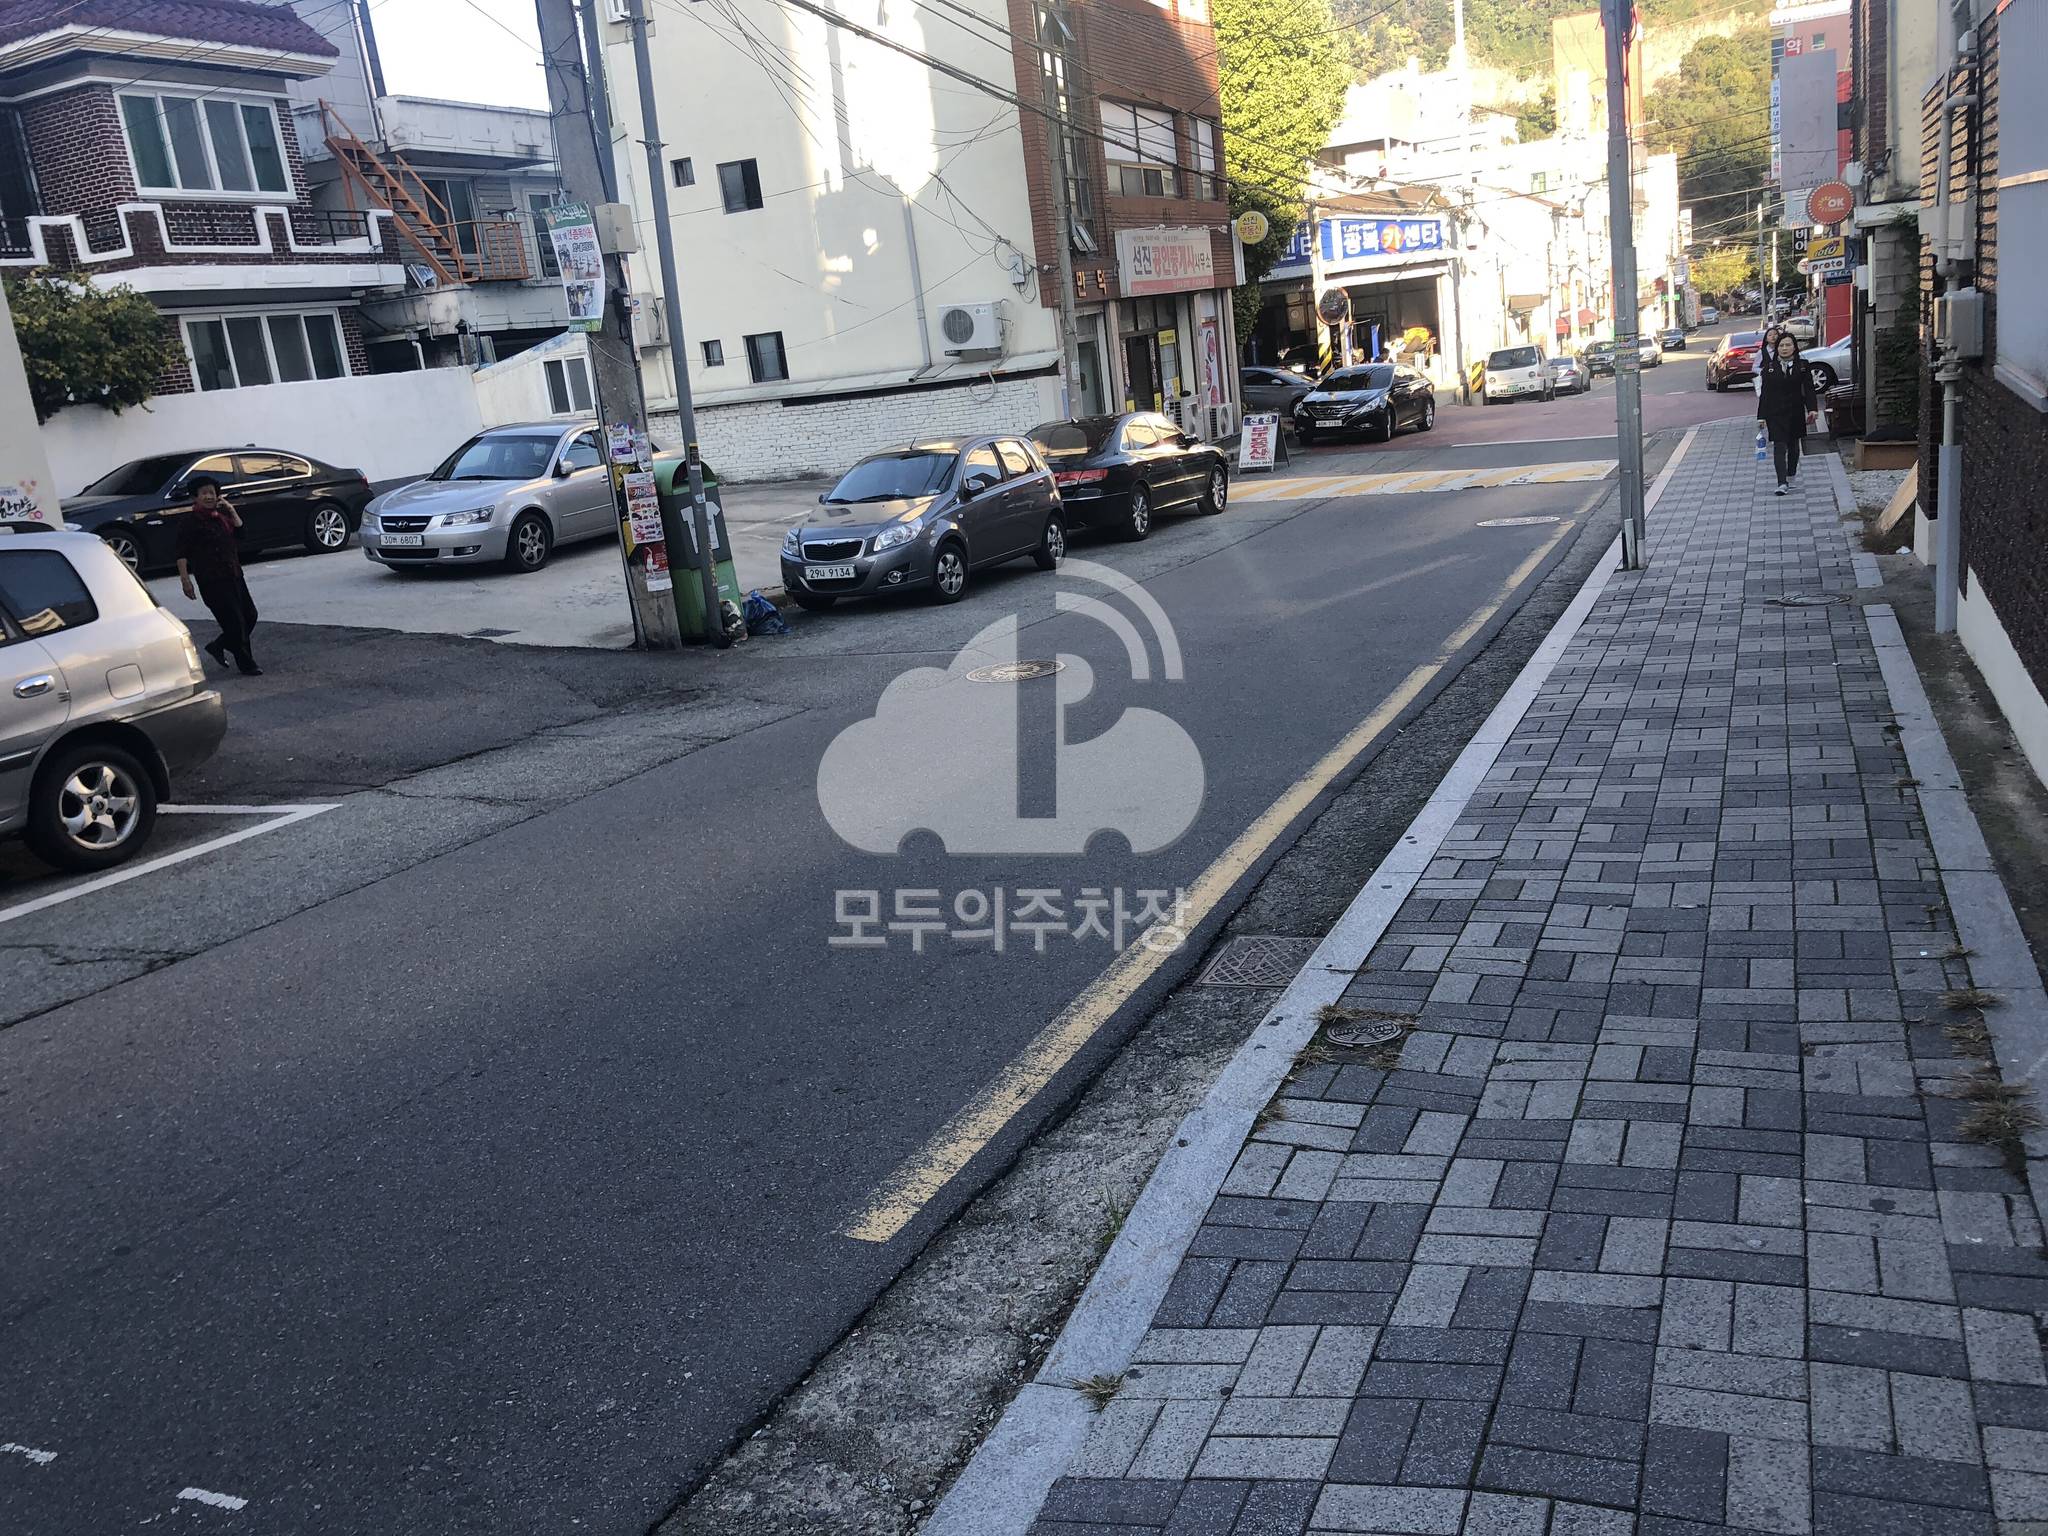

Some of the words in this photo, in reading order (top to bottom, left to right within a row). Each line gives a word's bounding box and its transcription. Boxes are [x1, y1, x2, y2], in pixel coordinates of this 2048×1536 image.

[1828, 197, 1845, 208] OK
[1242, 216, 1258, 225] 선진
[1240, 225, 1262, 236] 부동산
[1811, 259, 1843, 272] proto
[400, 535, 418, 545] 6807
[828, 567, 851, 578] 9134
